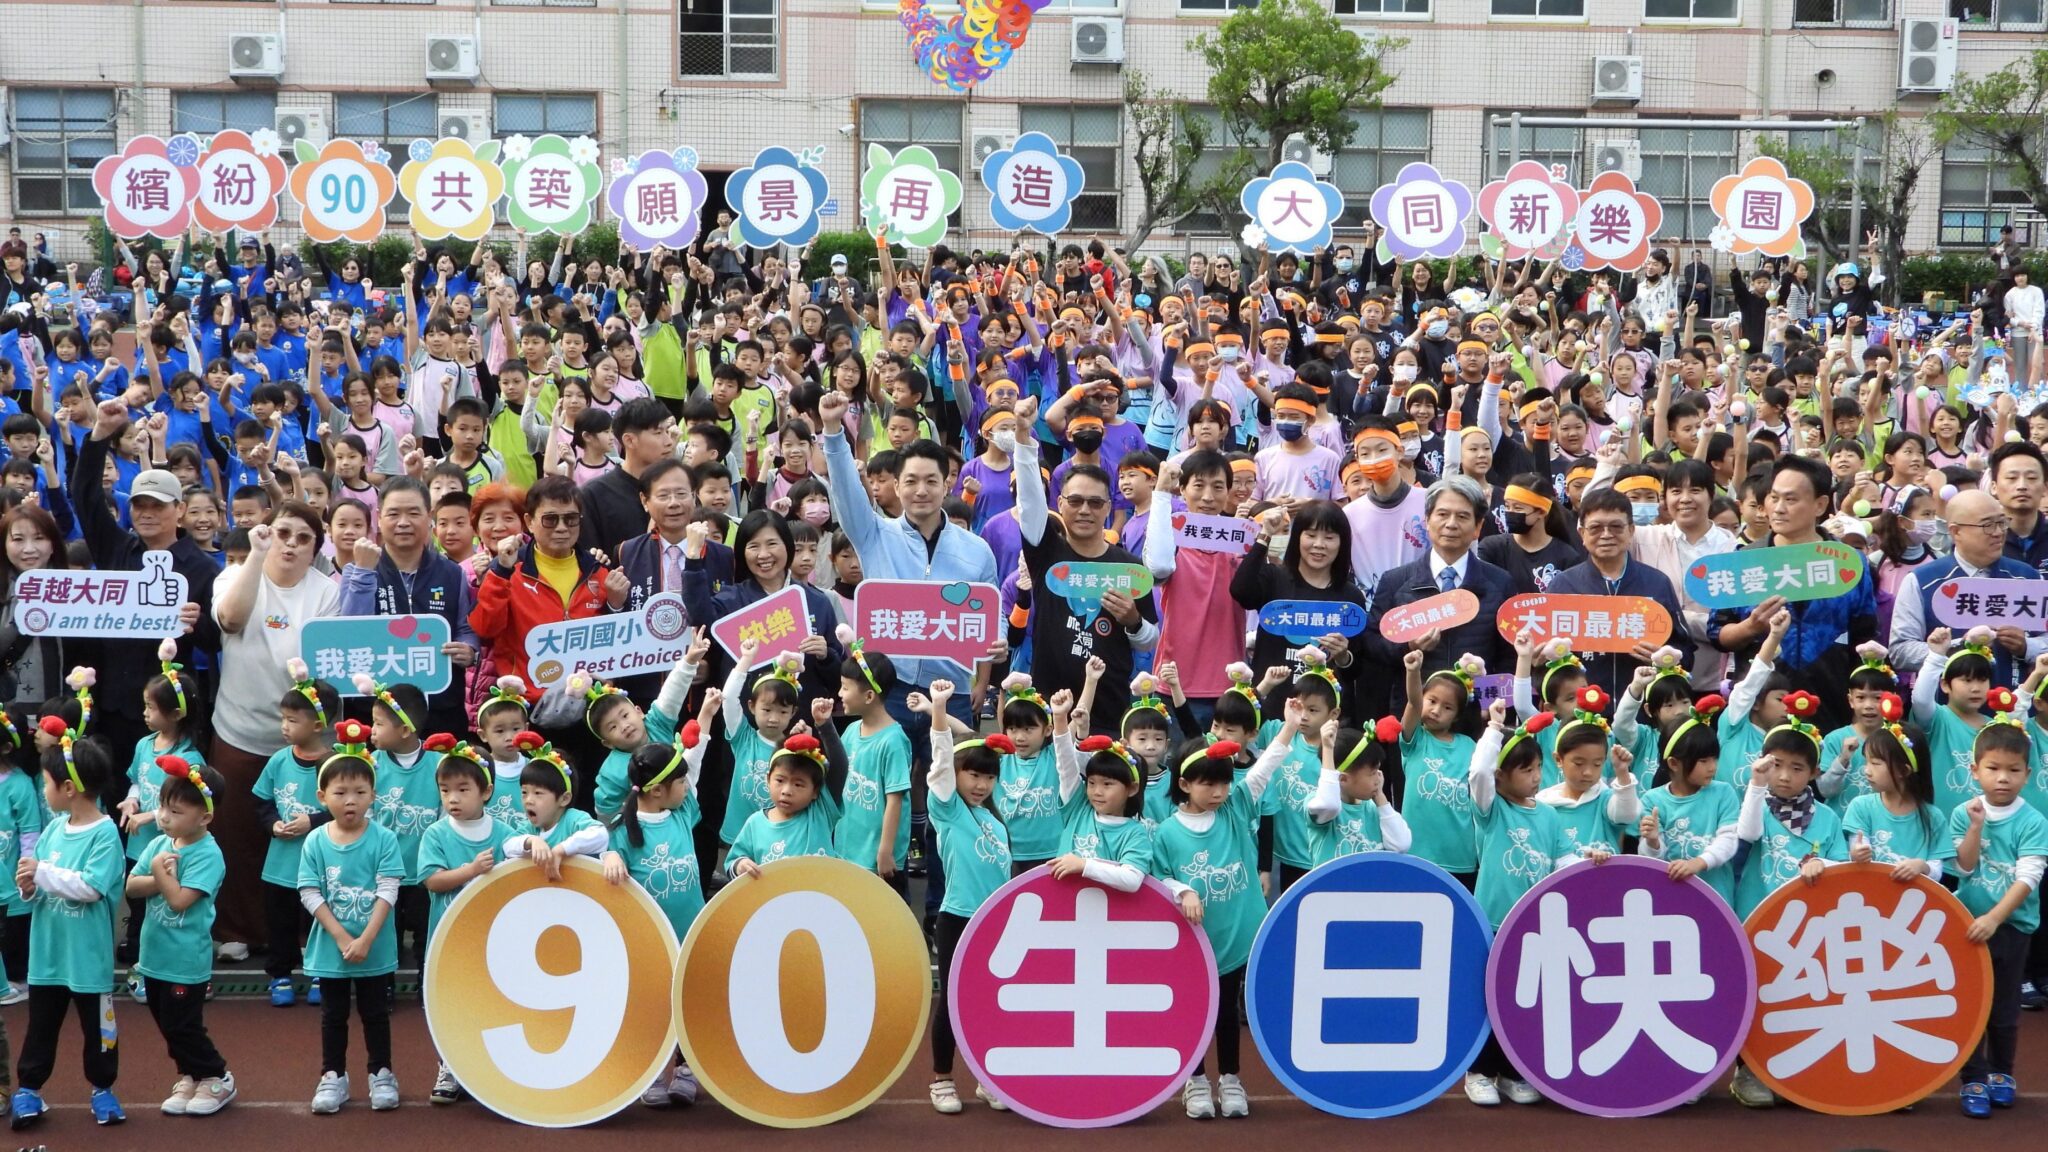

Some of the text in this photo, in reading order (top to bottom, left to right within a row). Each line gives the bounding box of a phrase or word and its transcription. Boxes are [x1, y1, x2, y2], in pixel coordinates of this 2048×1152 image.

[126, 167, 170, 211] 繽
[213, 163, 256, 205] 紛
[321, 173, 366, 213] 90
[432, 171, 472, 213] 共
[529, 168, 572, 209] 築
[757, 180, 799, 221] 景
[889, 177, 932, 222] 再
[1010, 163, 1053, 209] 造
[637, 183, 679, 226] 願
[1273, 191, 1312, 227] 大
[1402, 195, 1442, 234] 同
[1509, 193, 1550, 234] 新
[1589, 203, 1632, 244] 樂
[1741, 189, 1782, 230] 園
[1184, 524, 1246, 544] 我愛大同
[17, 576, 129, 606] 卓越大同
[1067, 572, 1132, 589] 我愛大同
[1707, 559, 1837, 597] 我愛大同
[58, 615, 89, 630] am
[94, 613, 124, 630] the
[128, 613, 180, 631] best!
[1278, 611, 1342, 628] 大同最棒
[1397, 602, 1457, 632] 大同最棒
[1513, 596, 1547, 609] GOOD
[536, 617, 643, 657] 大同國小
[738, 606, 797, 645] 快樂
[870, 609, 987, 642] 我愛大同
[1073, 632, 1094, 650] 大同
[1518, 609, 1647, 640] 大同最棒
[315, 645, 437, 681] 我愛大同
[573, 656, 615, 675] Best
[1071, 643, 1092, 660] 國小
[480, 887, 630, 1092] 9
[729, 891, 876, 1093] 0
[984, 888, 1181, 1076] 生
[1291, 891, 1454, 1072] 日
[1515, 888, 1718, 1080] 快
[1754, 888, 1959, 1079] 樂
